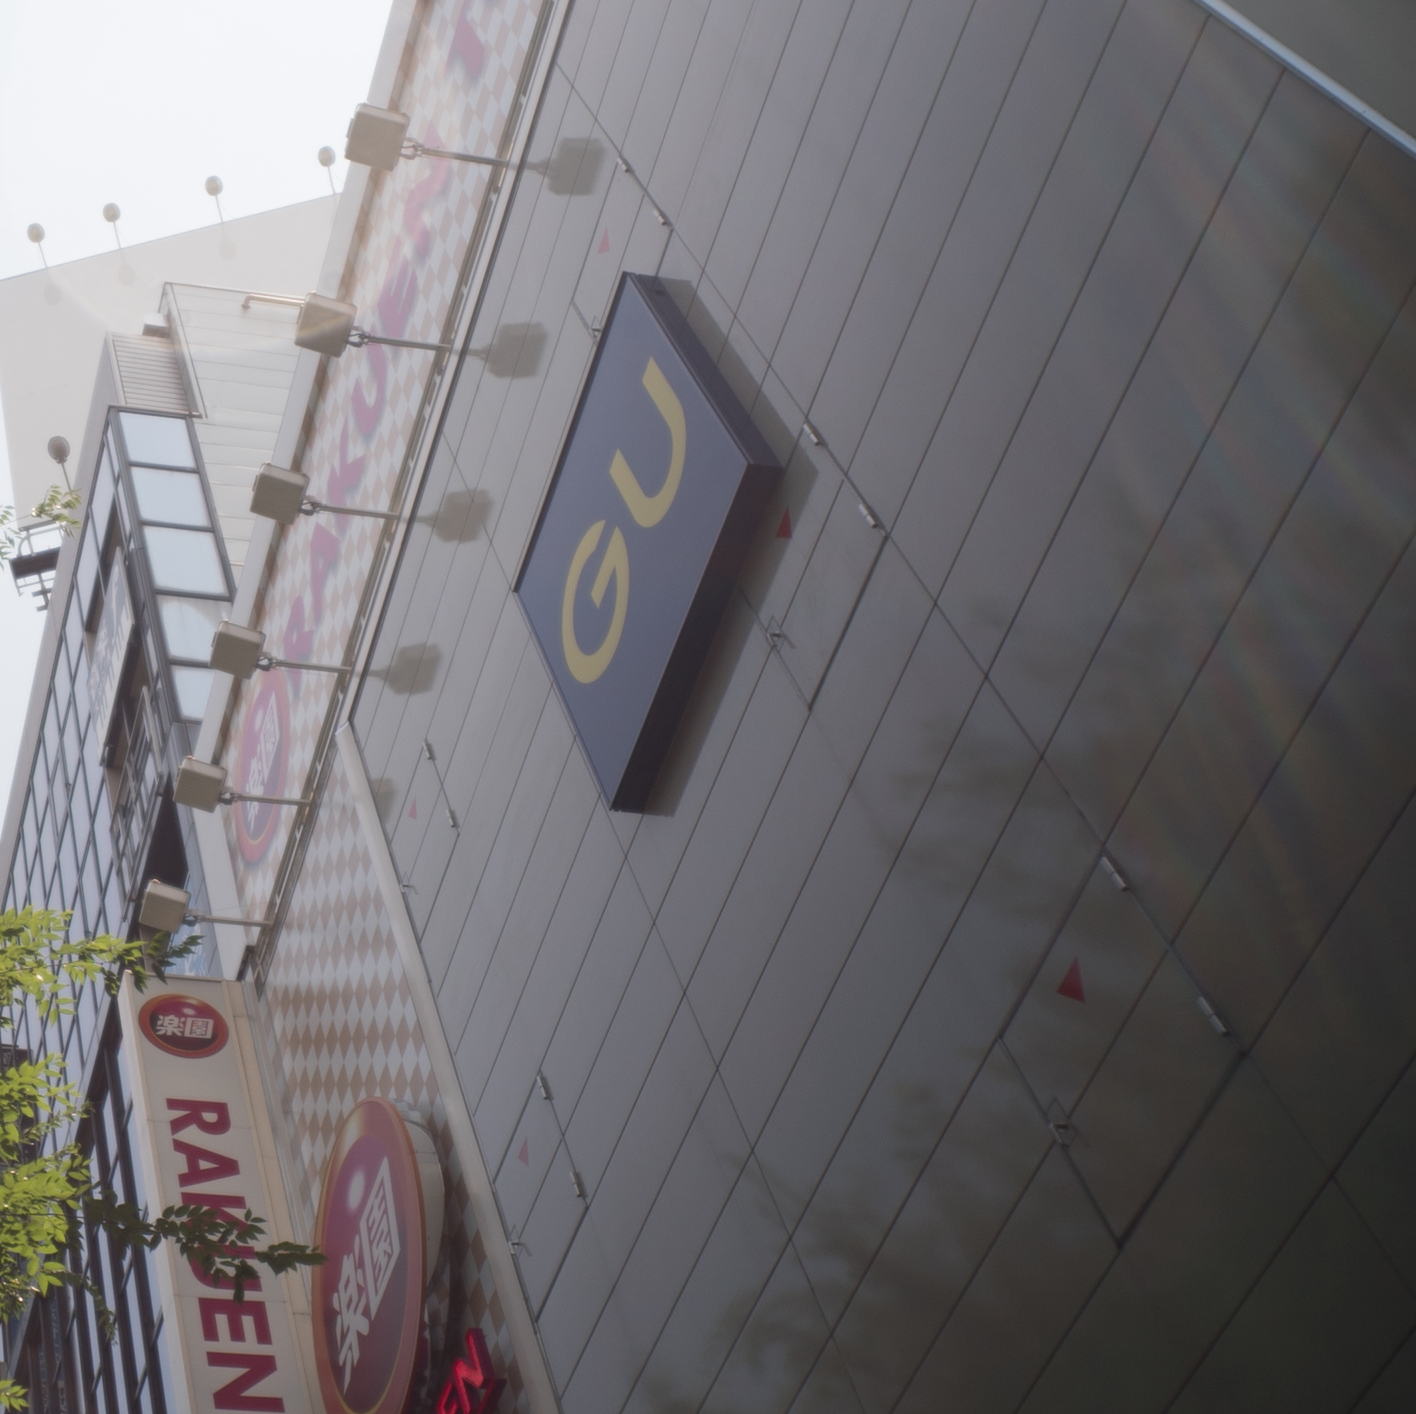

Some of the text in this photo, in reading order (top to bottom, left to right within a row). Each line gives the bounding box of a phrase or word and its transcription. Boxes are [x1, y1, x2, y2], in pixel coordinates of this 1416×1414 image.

[282, 122, 454, 700] RAKUEN
[562, 357, 687, 684] GU
[155, 1013, 215, 1040] 楽園
[165, 1097, 286, 1413] RAKUEN
[332, 1155, 401, 1396] 楽園
